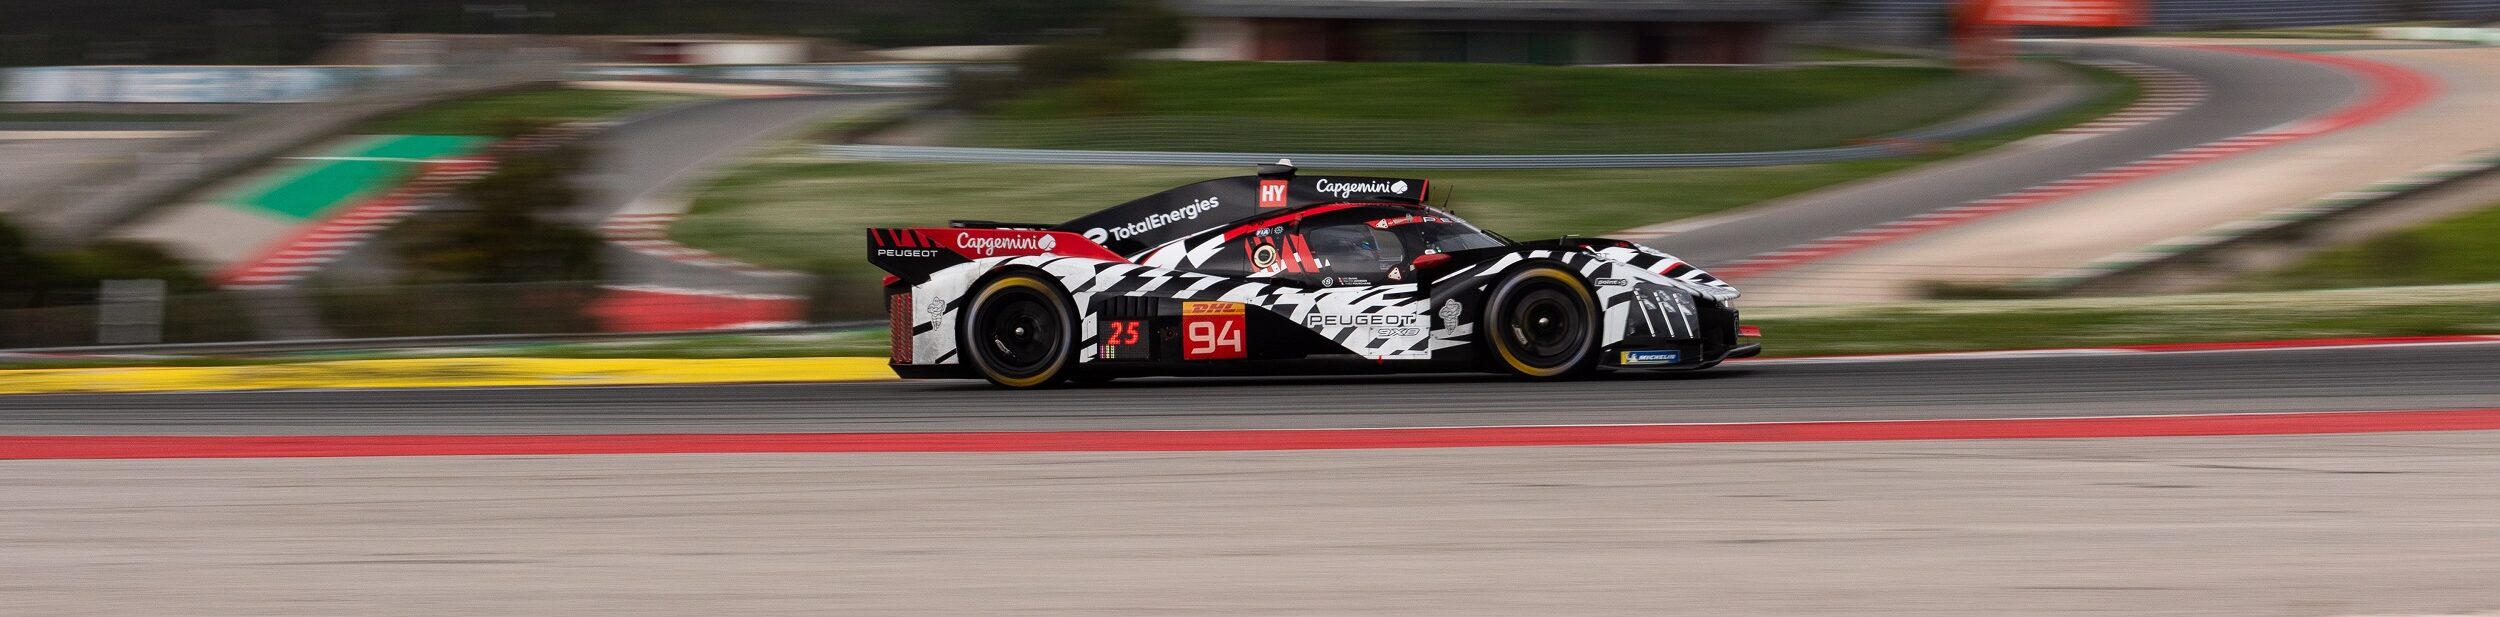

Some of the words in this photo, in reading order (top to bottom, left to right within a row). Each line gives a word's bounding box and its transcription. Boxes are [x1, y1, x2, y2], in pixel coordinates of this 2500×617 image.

[1262, 185, 1286, 202] HY
[1316, 179, 1390, 198] Capgemini
[1109, 196, 1219, 241] TotalEnergies
[877, 249, 938, 257] PEUGEOT
[957, 232, 1037, 255] Capgemini
[1192, 303, 1236, 313] DHL
[1309, 315, 1414, 326] PEUGEOT
[1108, 320, 1140, 345] 25
[1189, 320, 1242, 355] 94
